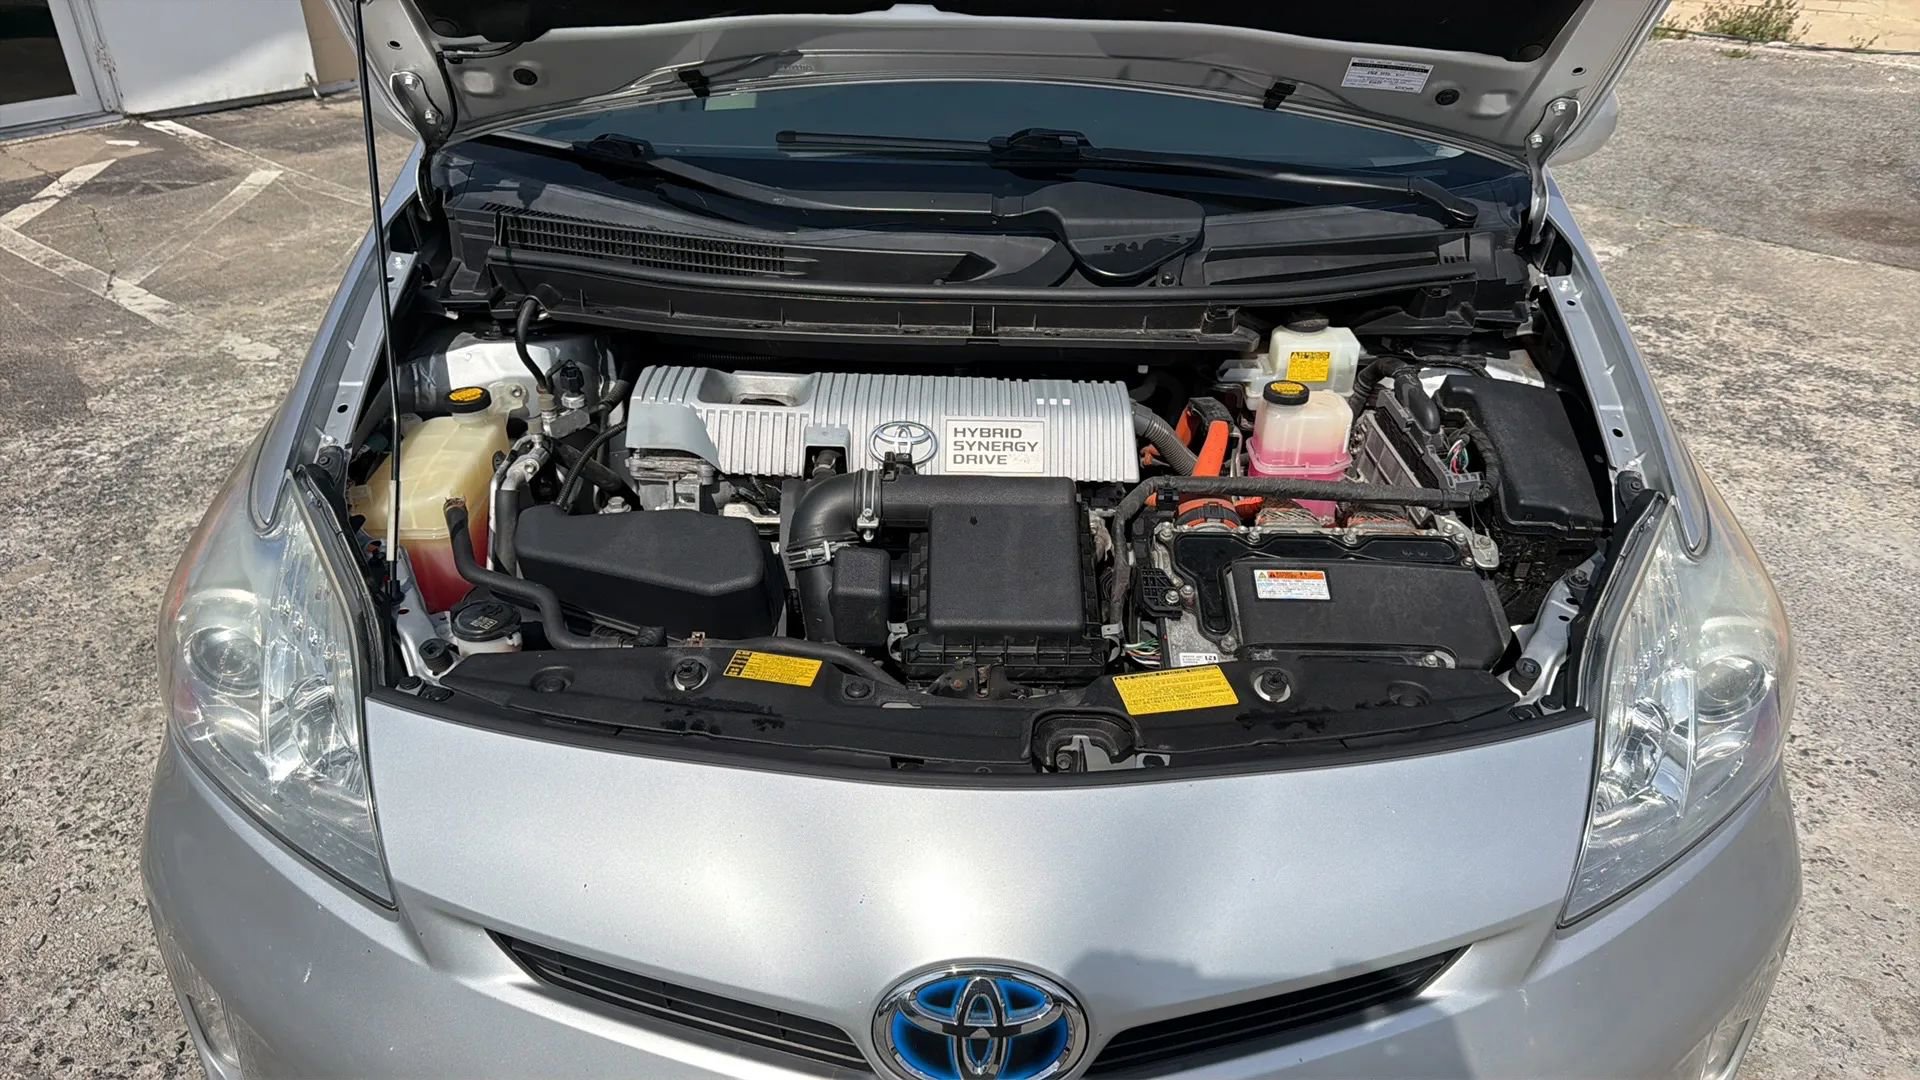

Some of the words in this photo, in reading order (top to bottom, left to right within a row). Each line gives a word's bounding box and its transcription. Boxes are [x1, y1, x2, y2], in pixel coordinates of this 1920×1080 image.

[953, 427, 1022, 439] HYBRID
[953, 441, 1039, 452] SYNERGY
[953, 454, 1008, 465] DRIVE
